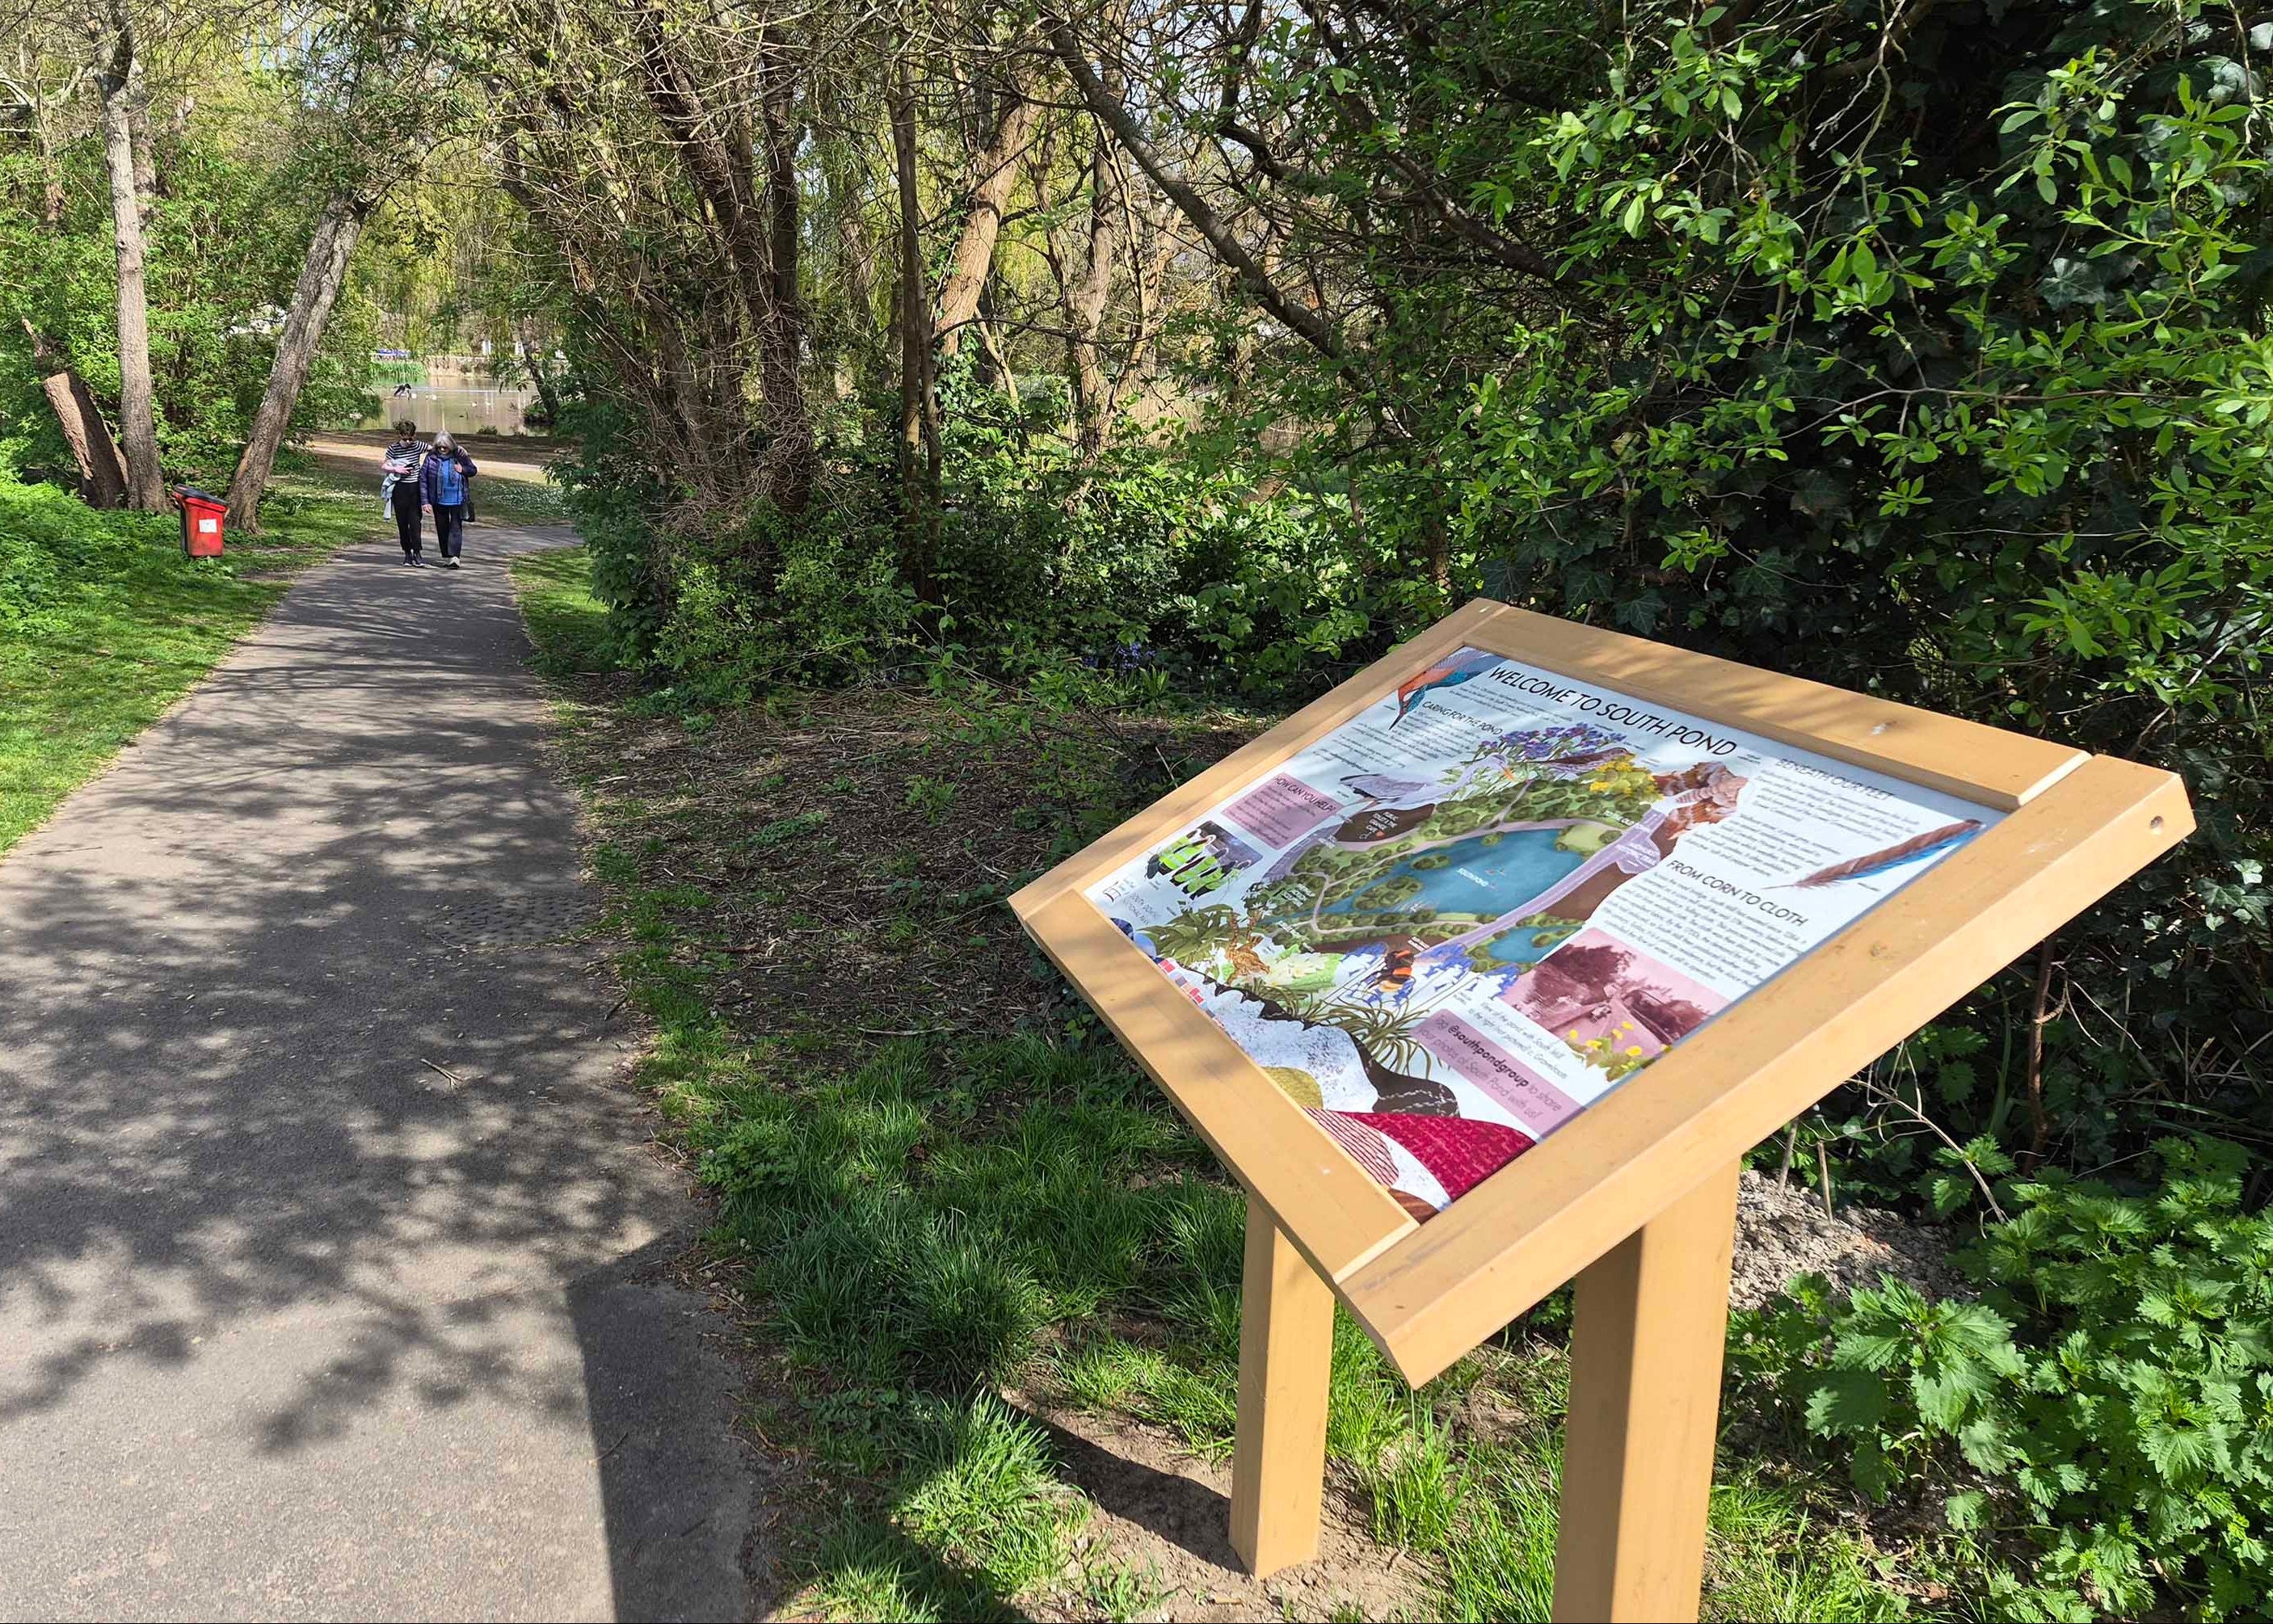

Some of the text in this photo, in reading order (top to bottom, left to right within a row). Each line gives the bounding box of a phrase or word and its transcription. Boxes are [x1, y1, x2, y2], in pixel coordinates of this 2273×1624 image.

[1420, 701, 1453, 715] CARING
[1446, 710, 1467, 721] FOR
[1461, 716, 1482, 726] THE
[1476, 722, 1505, 735] POND
[1485, 667, 1576, 702] WELCOME
[1567, 694, 1603, 711] TO
[1595, 703, 1673, 734] SOUTH
[1665, 726, 1740, 756] POND
[1774, 759, 1833, 781] BENEATH
[1829, 776, 1864, 791] OUR
[1271, 776, 1336, 813] HOW CAN YOU HELP?
[1665, 860, 1810, 926] FROM CORN TO CLOTH
[1429, 1037, 1461, 1061] photos
[1454, 1054, 1470, 1067] of
[1462, 1061, 1492, 1082] South
[1484, 1077, 1513, 1098] Pond
[1505, 1092, 1531, 1111] with
[1443, 1024, 1534, 1089] @southpondgroup
[1525, 1082, 1544, 1096] to
[1534, 1088, 1568, 1112] share
